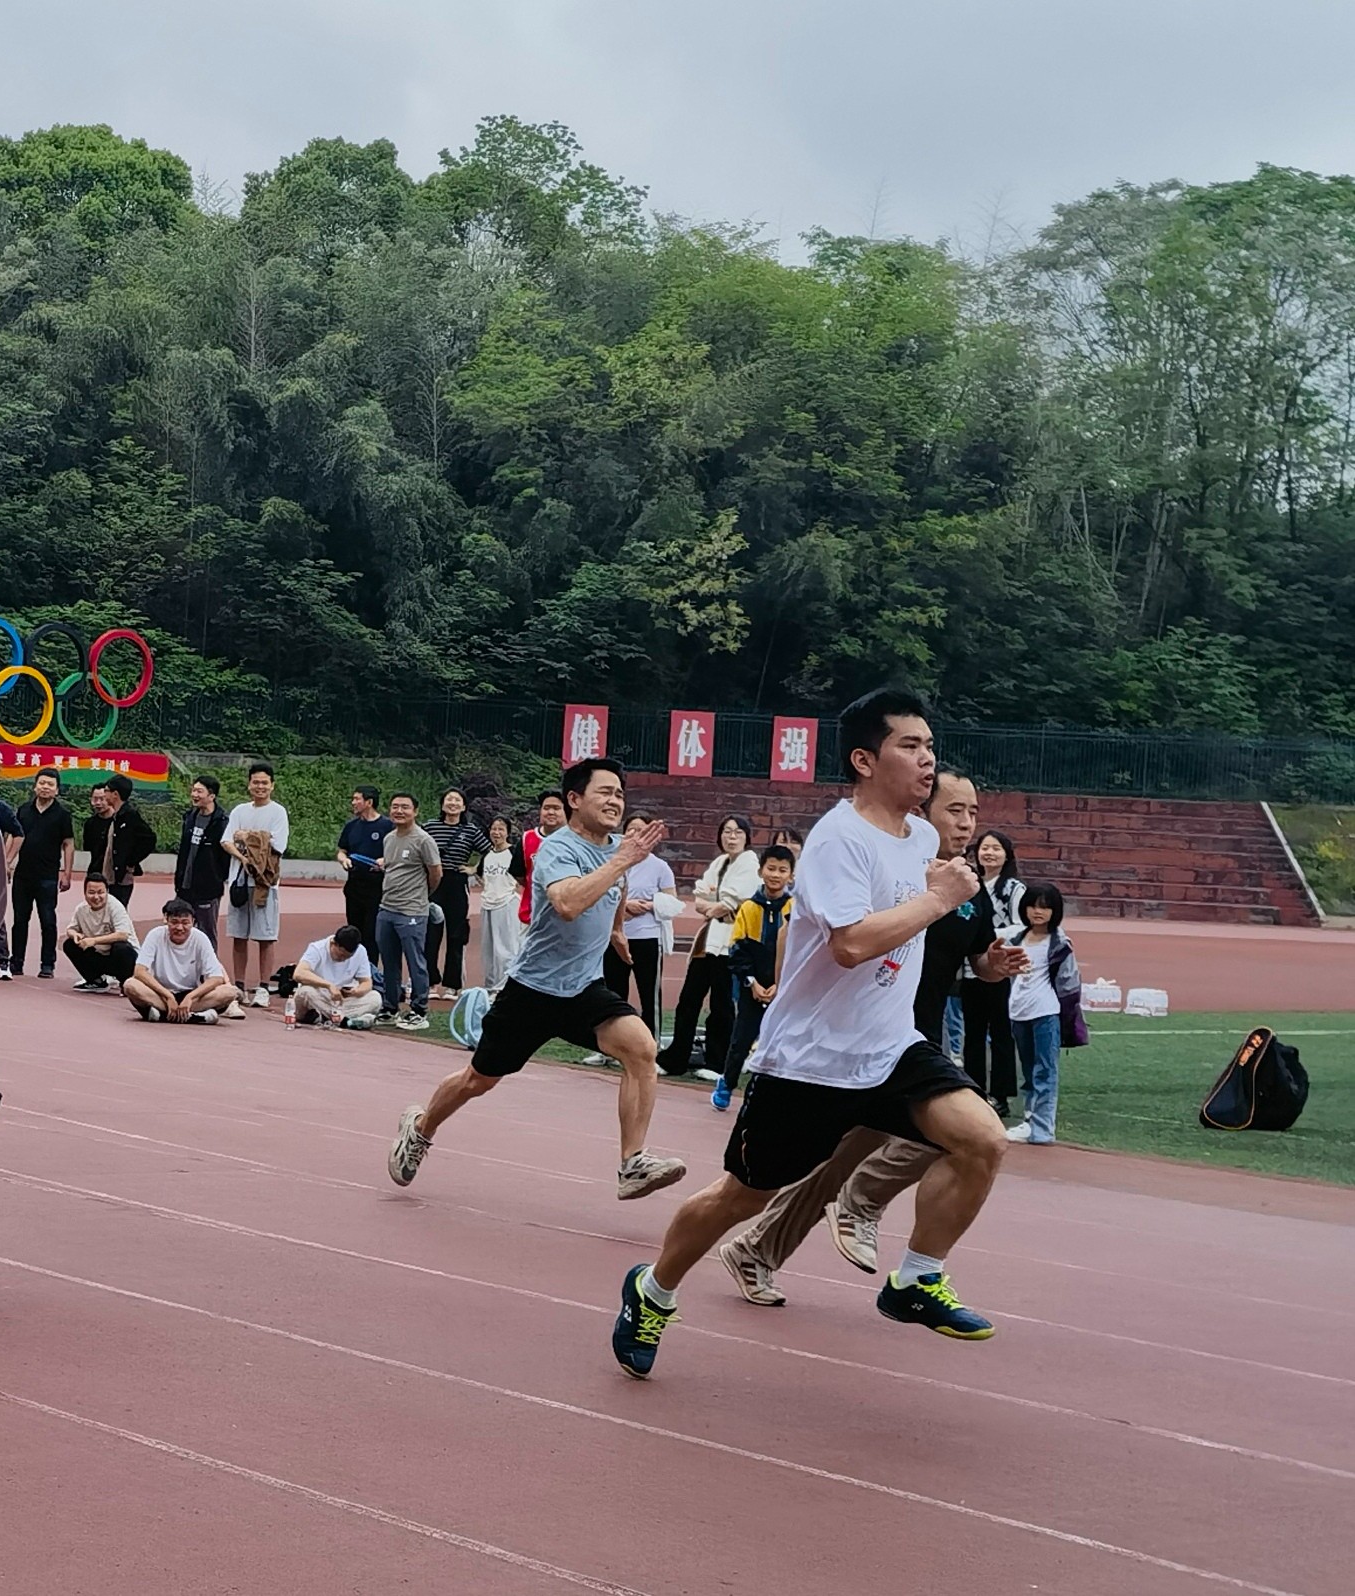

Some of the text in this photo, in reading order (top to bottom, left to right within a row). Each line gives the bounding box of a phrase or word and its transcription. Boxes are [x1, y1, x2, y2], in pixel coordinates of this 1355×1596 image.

[570, 713, 809, 772] 健 体 强
